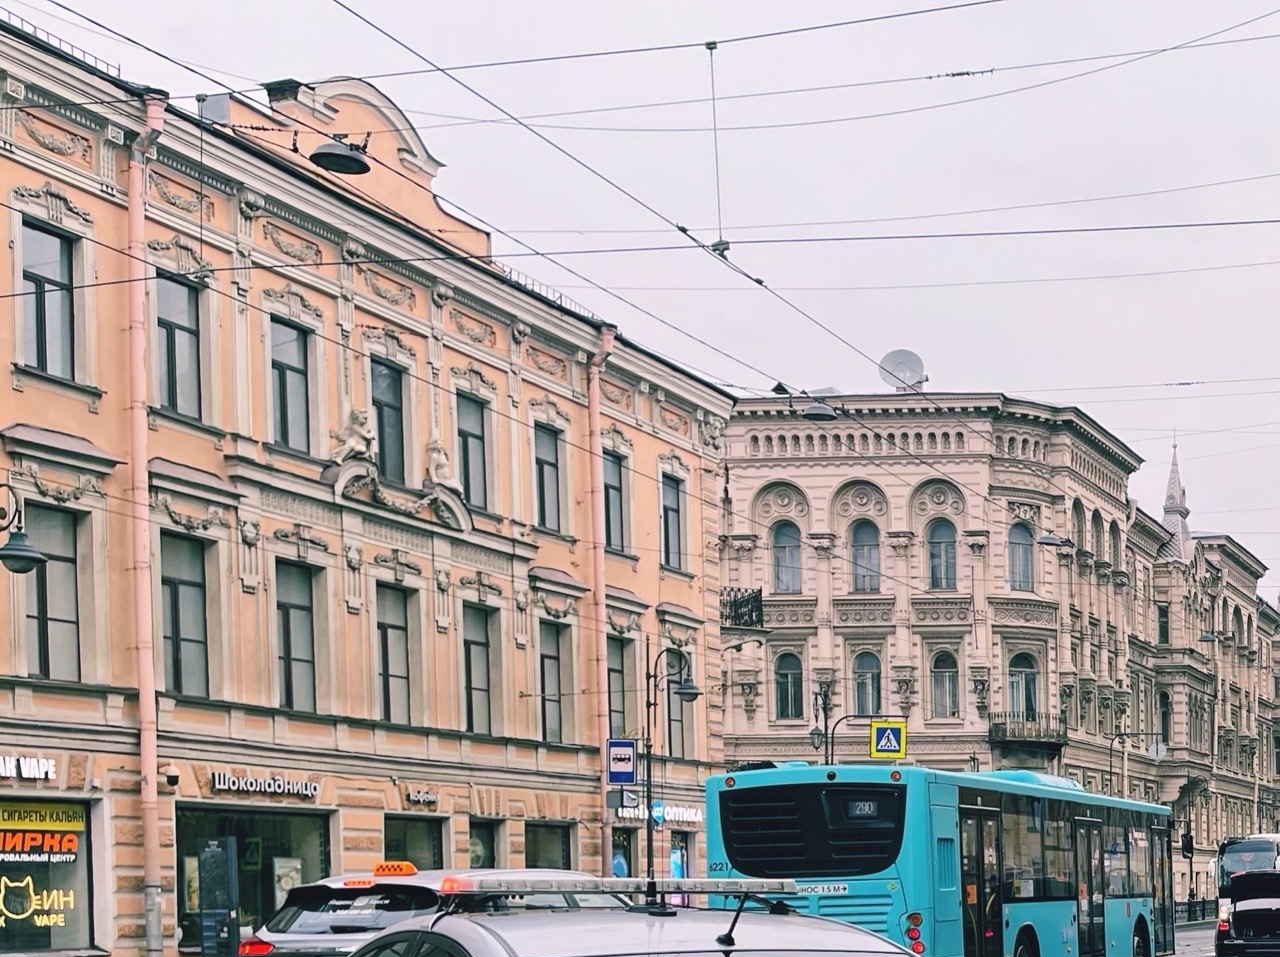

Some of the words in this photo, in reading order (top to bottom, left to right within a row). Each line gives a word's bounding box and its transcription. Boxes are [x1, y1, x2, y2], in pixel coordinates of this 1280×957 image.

[20, 757, 57, 779] VAPE
[214, 771, 320, 798] Шоколадница
[1, 809, 47, 822] СИГАРЕТЫ
[49, 810, 84, 823] КАЛЬЯН
[50, 853, 76, 863] ЦЕНТР
[33, 914, 66, 927] VAPE
